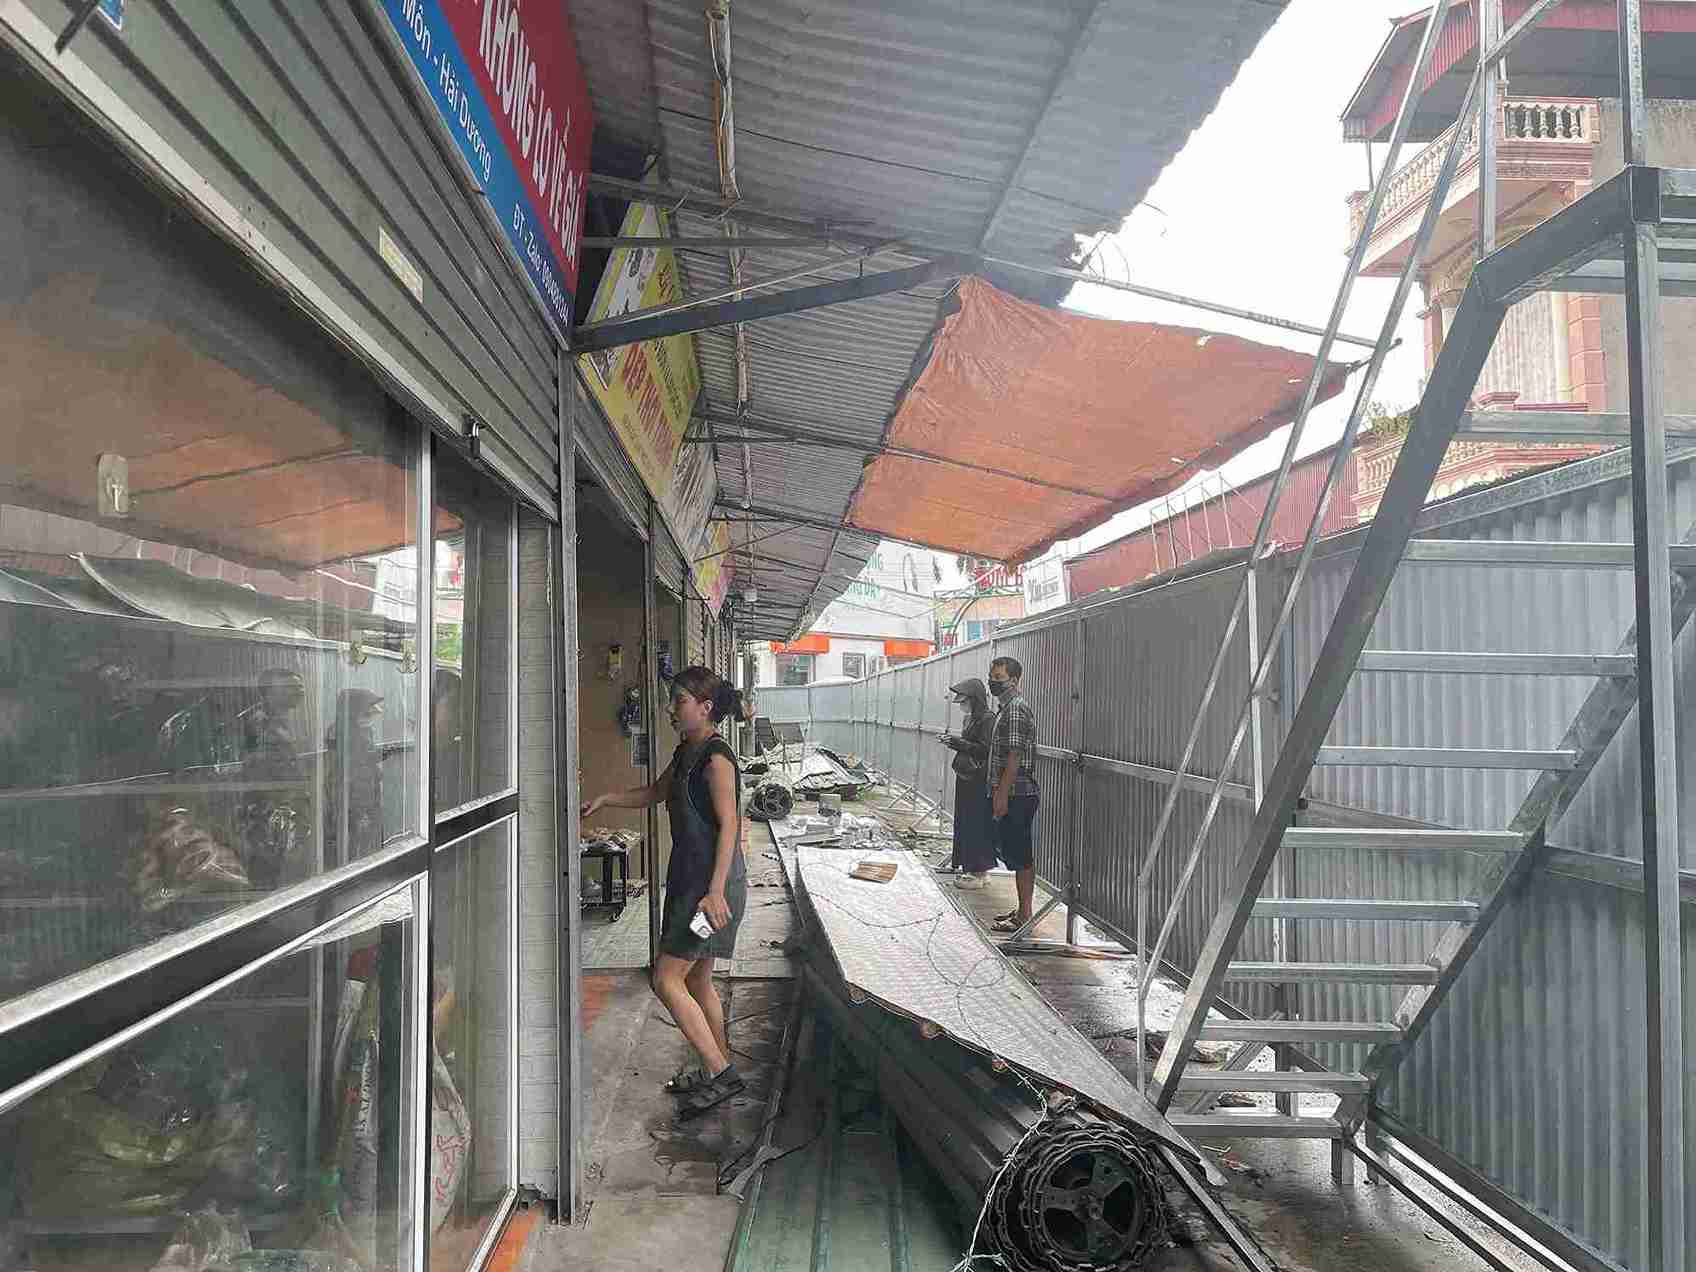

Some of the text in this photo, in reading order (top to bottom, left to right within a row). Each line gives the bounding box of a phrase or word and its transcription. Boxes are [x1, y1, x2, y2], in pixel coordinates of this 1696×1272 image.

[440, 52, 460, 114] Hải
[459, 91, 492, 183] Dương
[533, 88, 553, 198] LO
